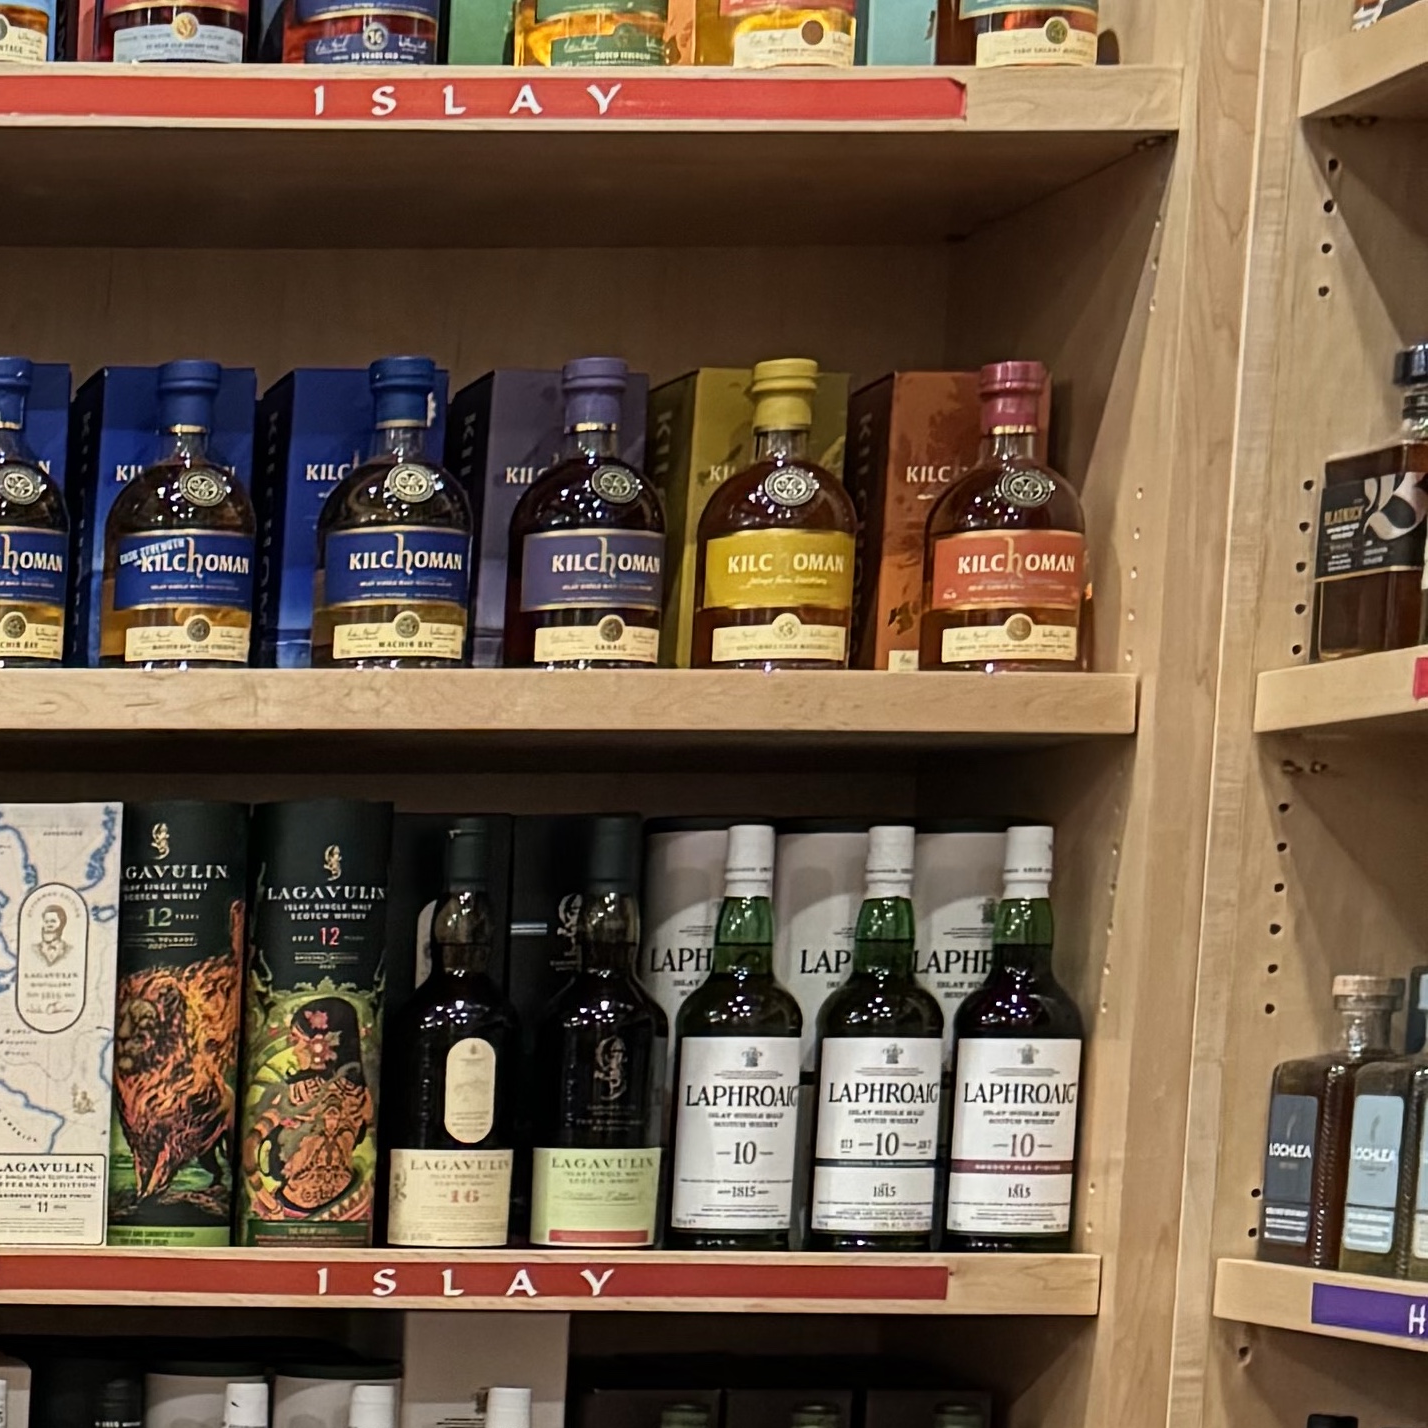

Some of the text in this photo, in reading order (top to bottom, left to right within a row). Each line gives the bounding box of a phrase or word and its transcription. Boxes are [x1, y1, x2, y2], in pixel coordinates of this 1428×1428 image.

[313, 83, 624, 118] ISLAY
[267, 886, 387, 900] LAGAVULIN
[147, 907, 172, 927] 12
[320, 927, 340, 946] 12
[963, 1081, 1077, 1105] LAPHROAIG
[733, 1142, 758, 1164] 10
[874, 1132, 900, 1155] 10
[1008, 1134, 1035, 1157] 10
[1268, 1143, 1312, 1159] LOCHLEA
[409, 1159, 509, 1172] LAGAVULIN
[551, 1156, 654, 1169] LAGAVULIN
[450, 1189, 481, 1204] 16
[731, 1185, 757, 1198] 1815
[37, 1202, 48, 1212] 11
[317, 1267, 615, 1298] ISLAY
